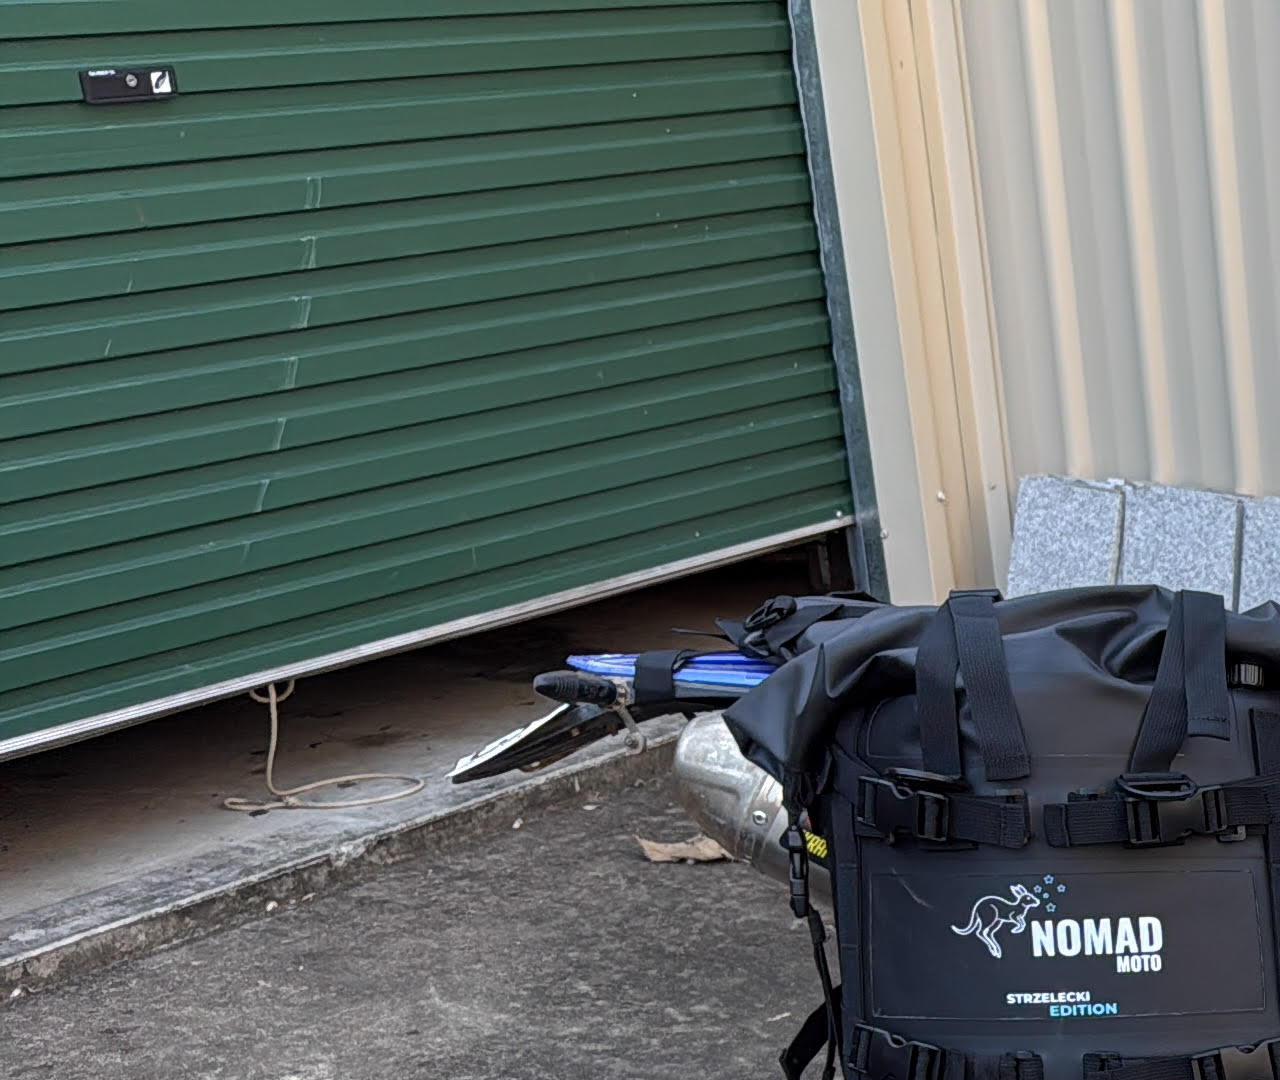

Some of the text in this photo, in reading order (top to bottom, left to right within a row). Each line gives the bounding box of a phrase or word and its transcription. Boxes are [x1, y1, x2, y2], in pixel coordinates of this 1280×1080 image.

[1030, 916, 1164, 957] NOMAD
[1116, 954, 1163, 973] MOTO
[1006, 990, 1091, 1004] STRZELECKI
[1049, 1002, 1119, 1017] EDITION
